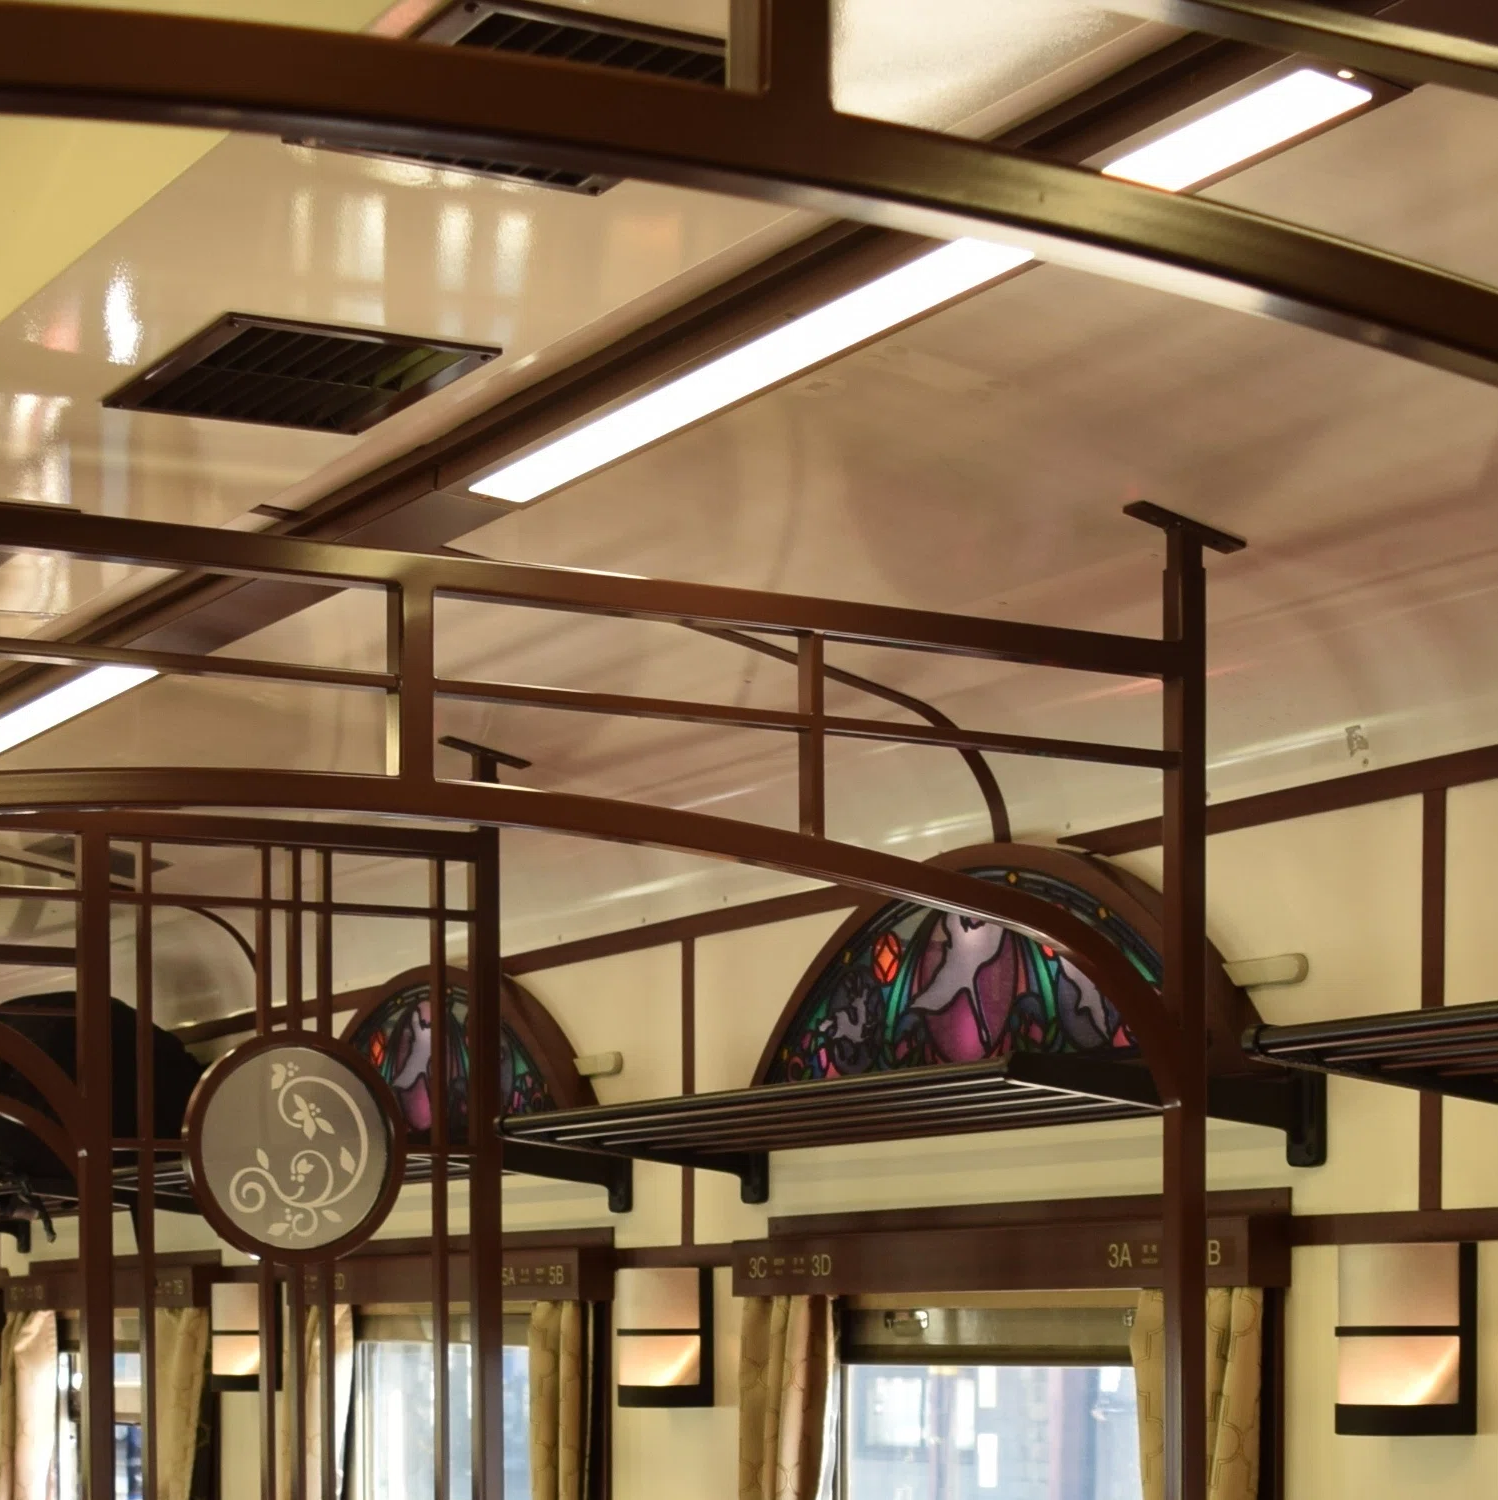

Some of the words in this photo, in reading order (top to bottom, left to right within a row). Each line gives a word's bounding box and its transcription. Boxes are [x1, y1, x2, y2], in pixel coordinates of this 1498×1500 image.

[811, 1253, 832, 1277] 3D
[1107, 1242, 1133, 1269] 3A
[1205, 1239, 1222, 1266] B
[748, 1255, 768, 1279] 3C
